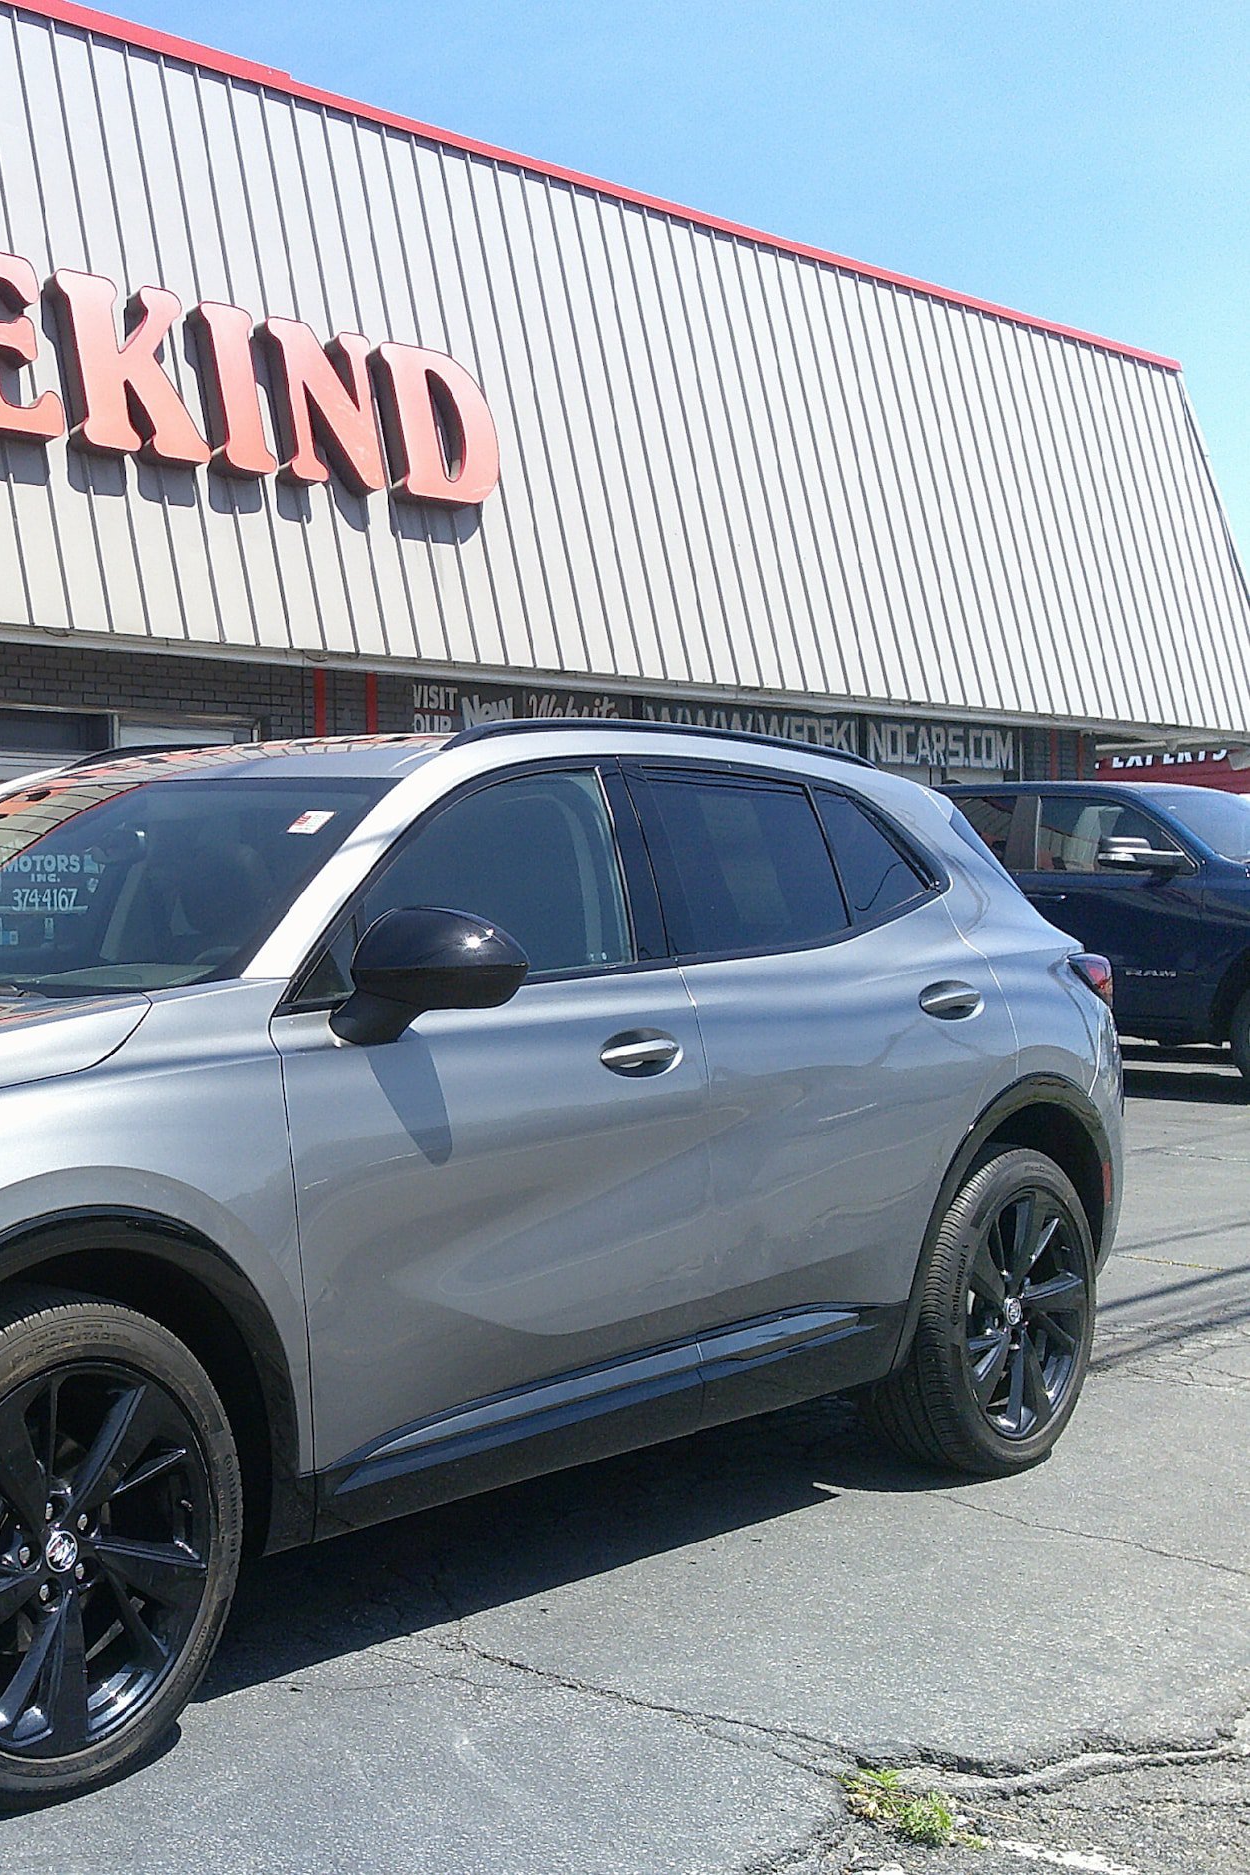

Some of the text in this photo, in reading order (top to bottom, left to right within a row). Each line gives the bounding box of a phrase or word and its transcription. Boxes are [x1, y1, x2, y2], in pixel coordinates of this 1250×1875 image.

[413, 684, 458, 710] VISIT
[1, 854, 81, 873] MOTORS
[951, 1252, 968, 1326] Continental
[225, 1453, 239, 1553] Continental
